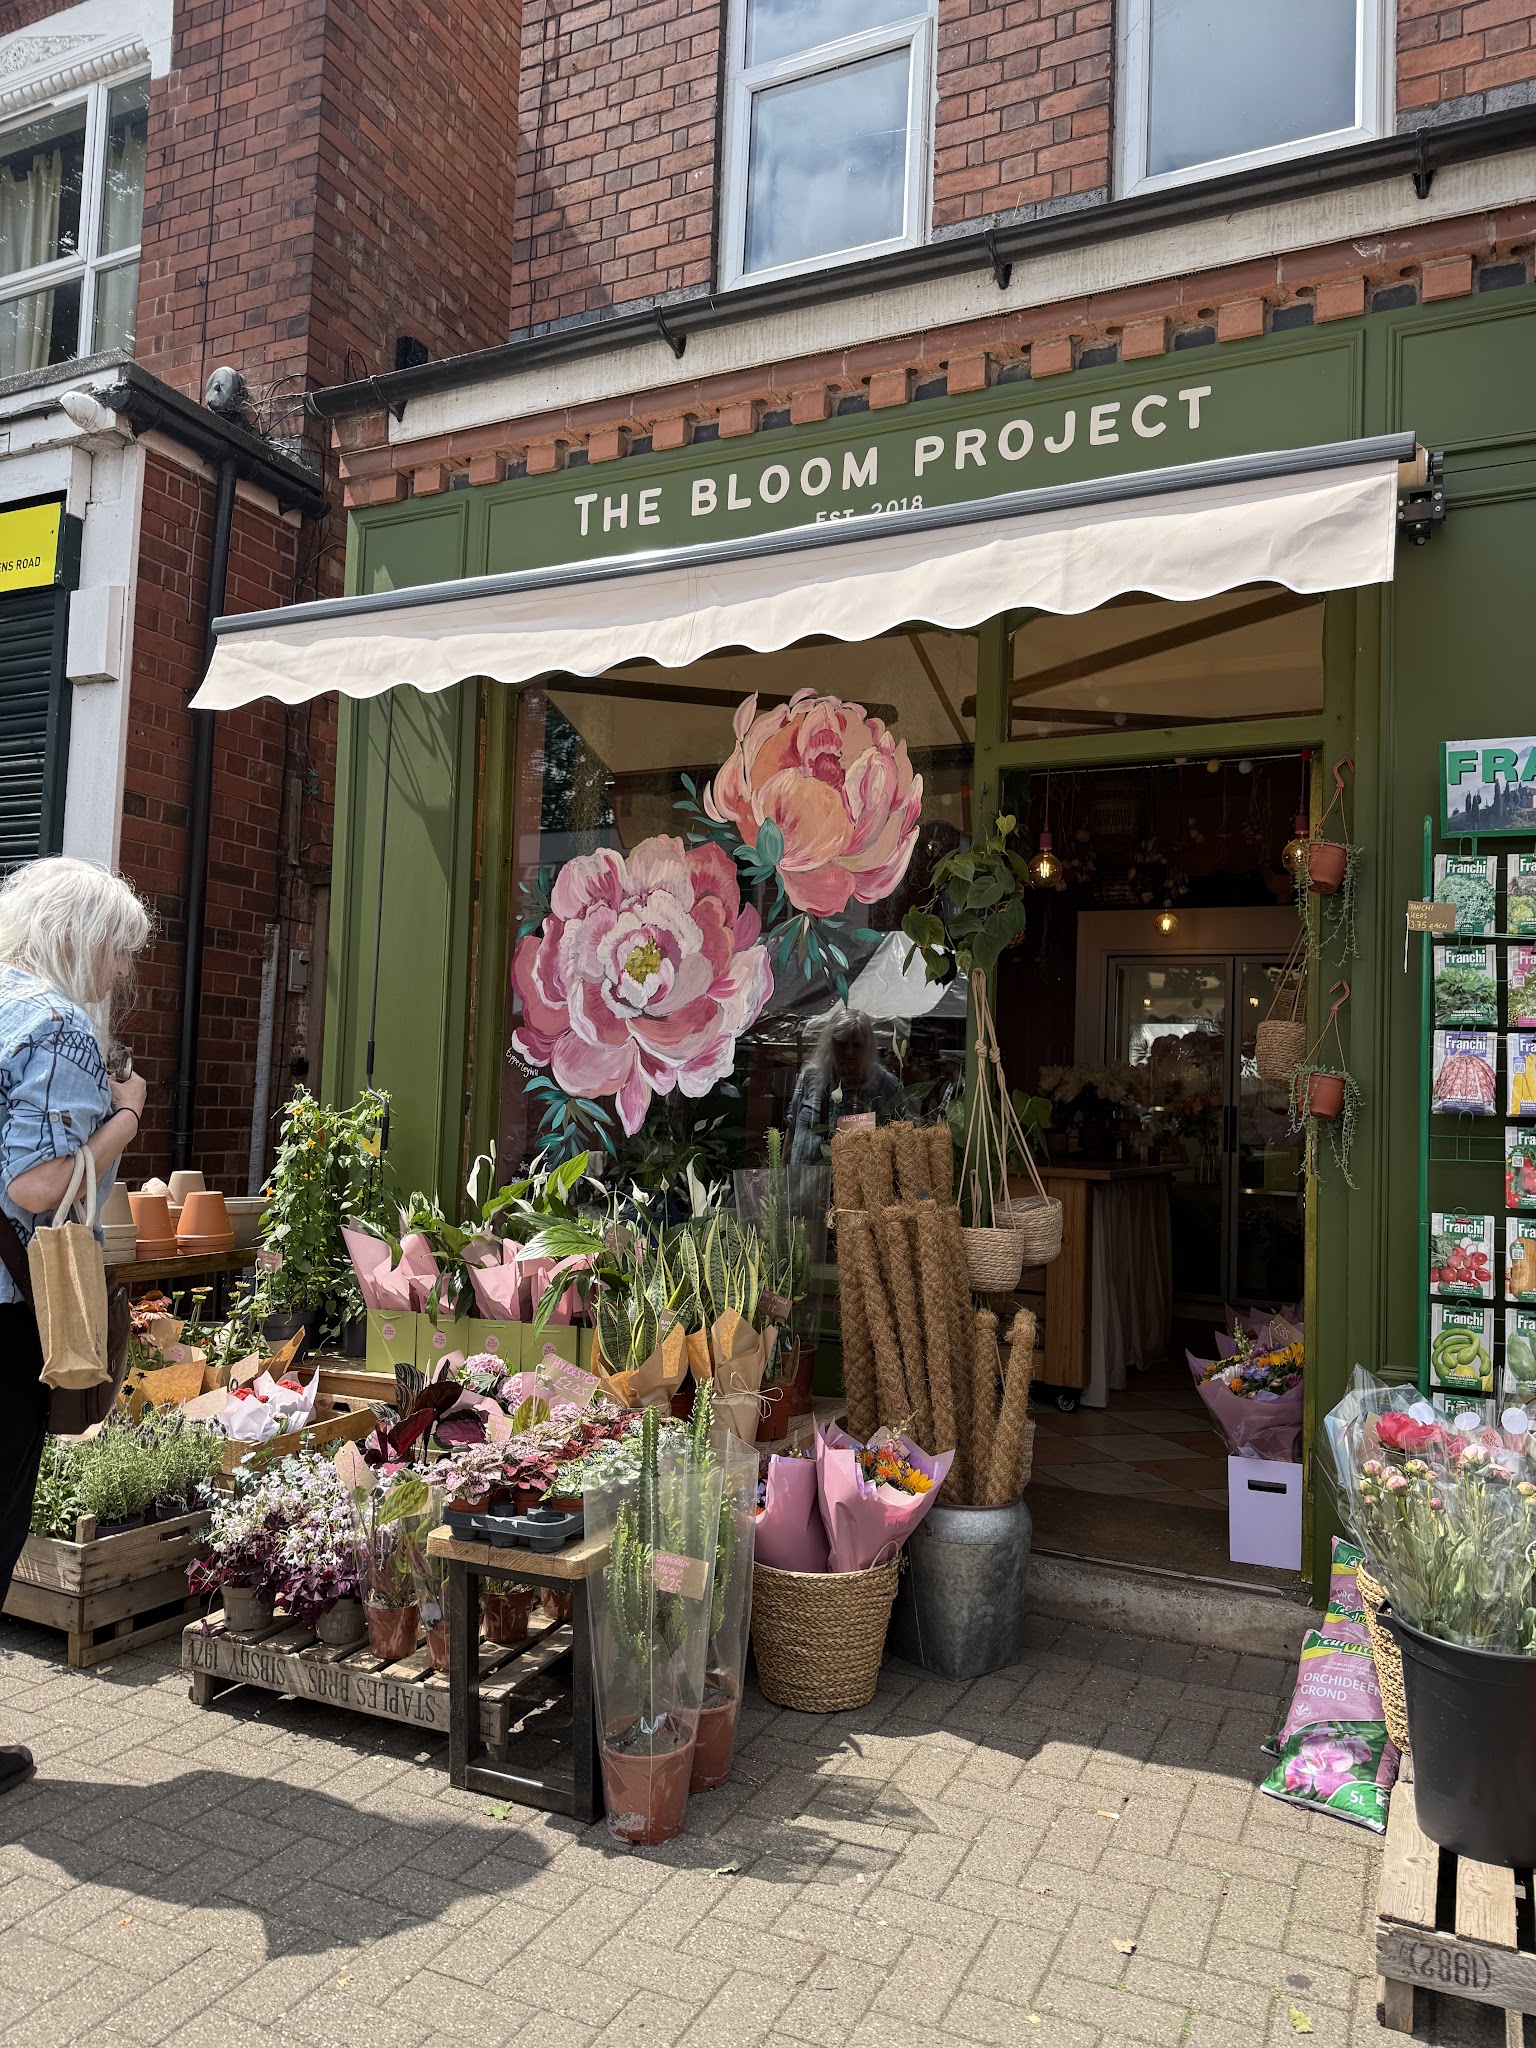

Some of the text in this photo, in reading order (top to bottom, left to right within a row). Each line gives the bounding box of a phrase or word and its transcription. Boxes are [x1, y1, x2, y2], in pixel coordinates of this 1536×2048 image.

[574, 385, 1212, 536] THE BLOOM PROJECT
[870, 494, 924, 515] 2018
[16, 556, 41, 570] ROAD
[1446, 859, 1487, 874] Franchi
[1445, 949, 1486, 964] Franchi
[1445, 1035, 1486, 1050] Franchi
[1443, 1218, 1484, 1234] Franchi
[1443, 1309, 1484, 1326] Franchi
[552, 1357, 598, 1385] HYPOESTES
[657, 1575, 683, 1592] £25
[304, 1664, 349, 1702] BROS.
[357, 1677, 436, 1723] STAPLES
[1300, 1684, 1347, 1701] GROND
